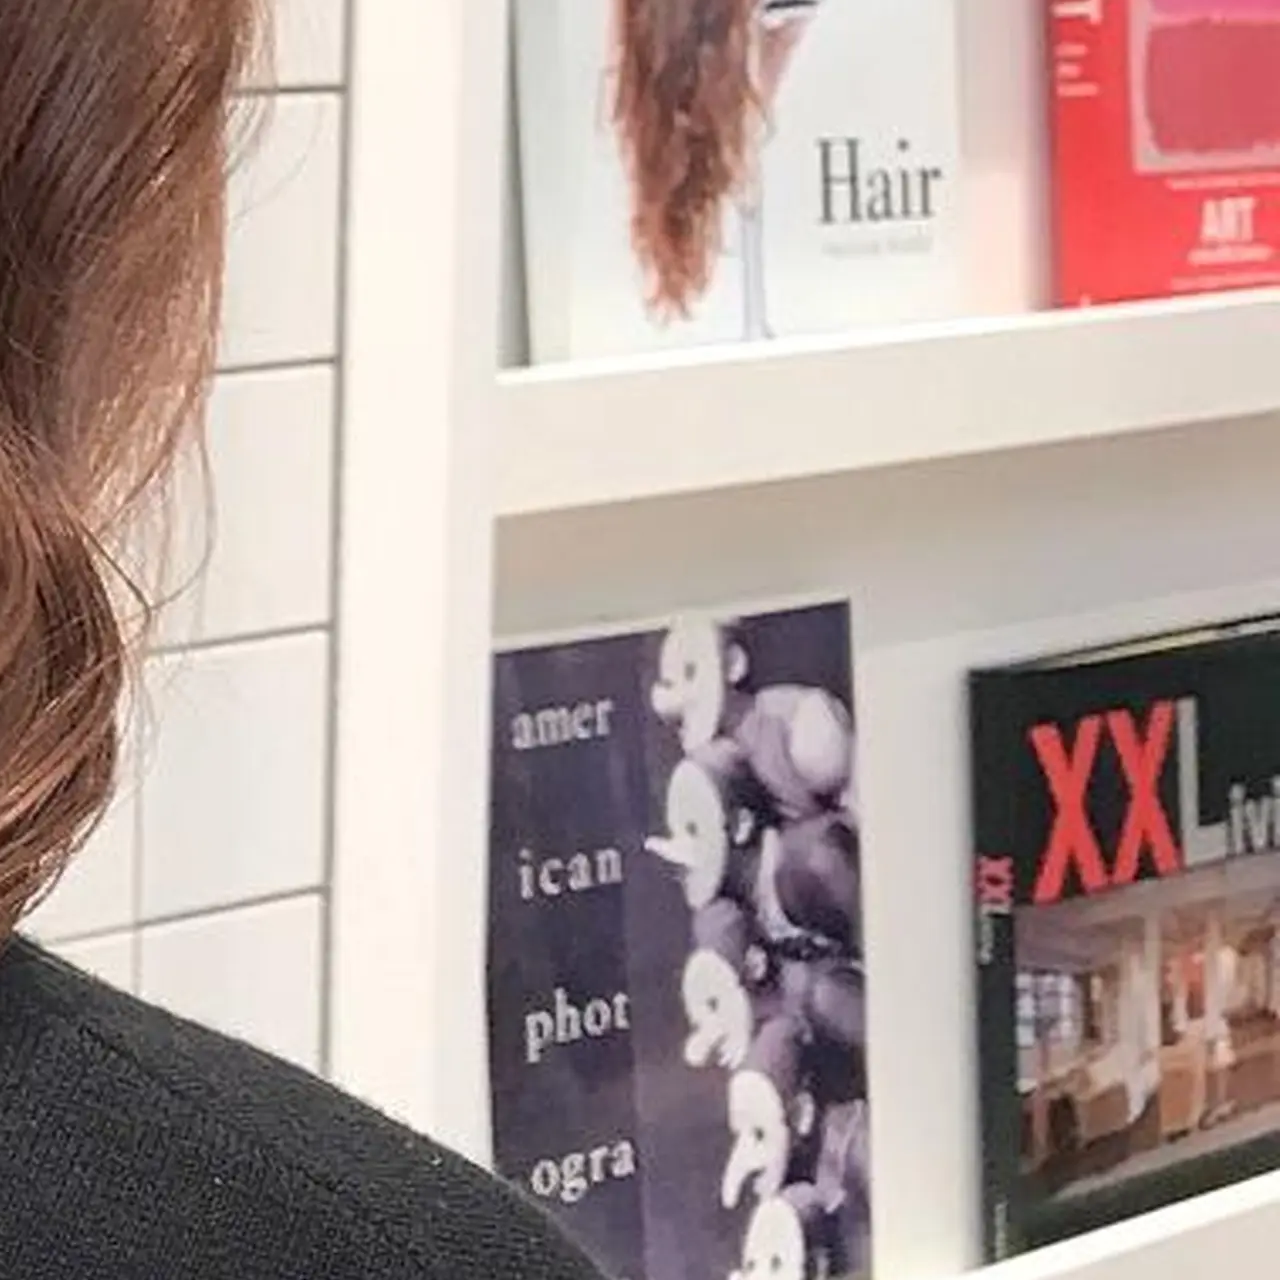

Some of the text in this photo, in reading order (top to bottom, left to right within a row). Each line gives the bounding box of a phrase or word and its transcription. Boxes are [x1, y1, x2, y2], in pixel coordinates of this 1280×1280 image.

[815, 135, 943, 225] Hair
[512, 699, 615, 751] amer
[519, 847, 624, 900] ican
[524, 986, 631, 1064] phot
[530, 1139, 636, 1204] ogra
